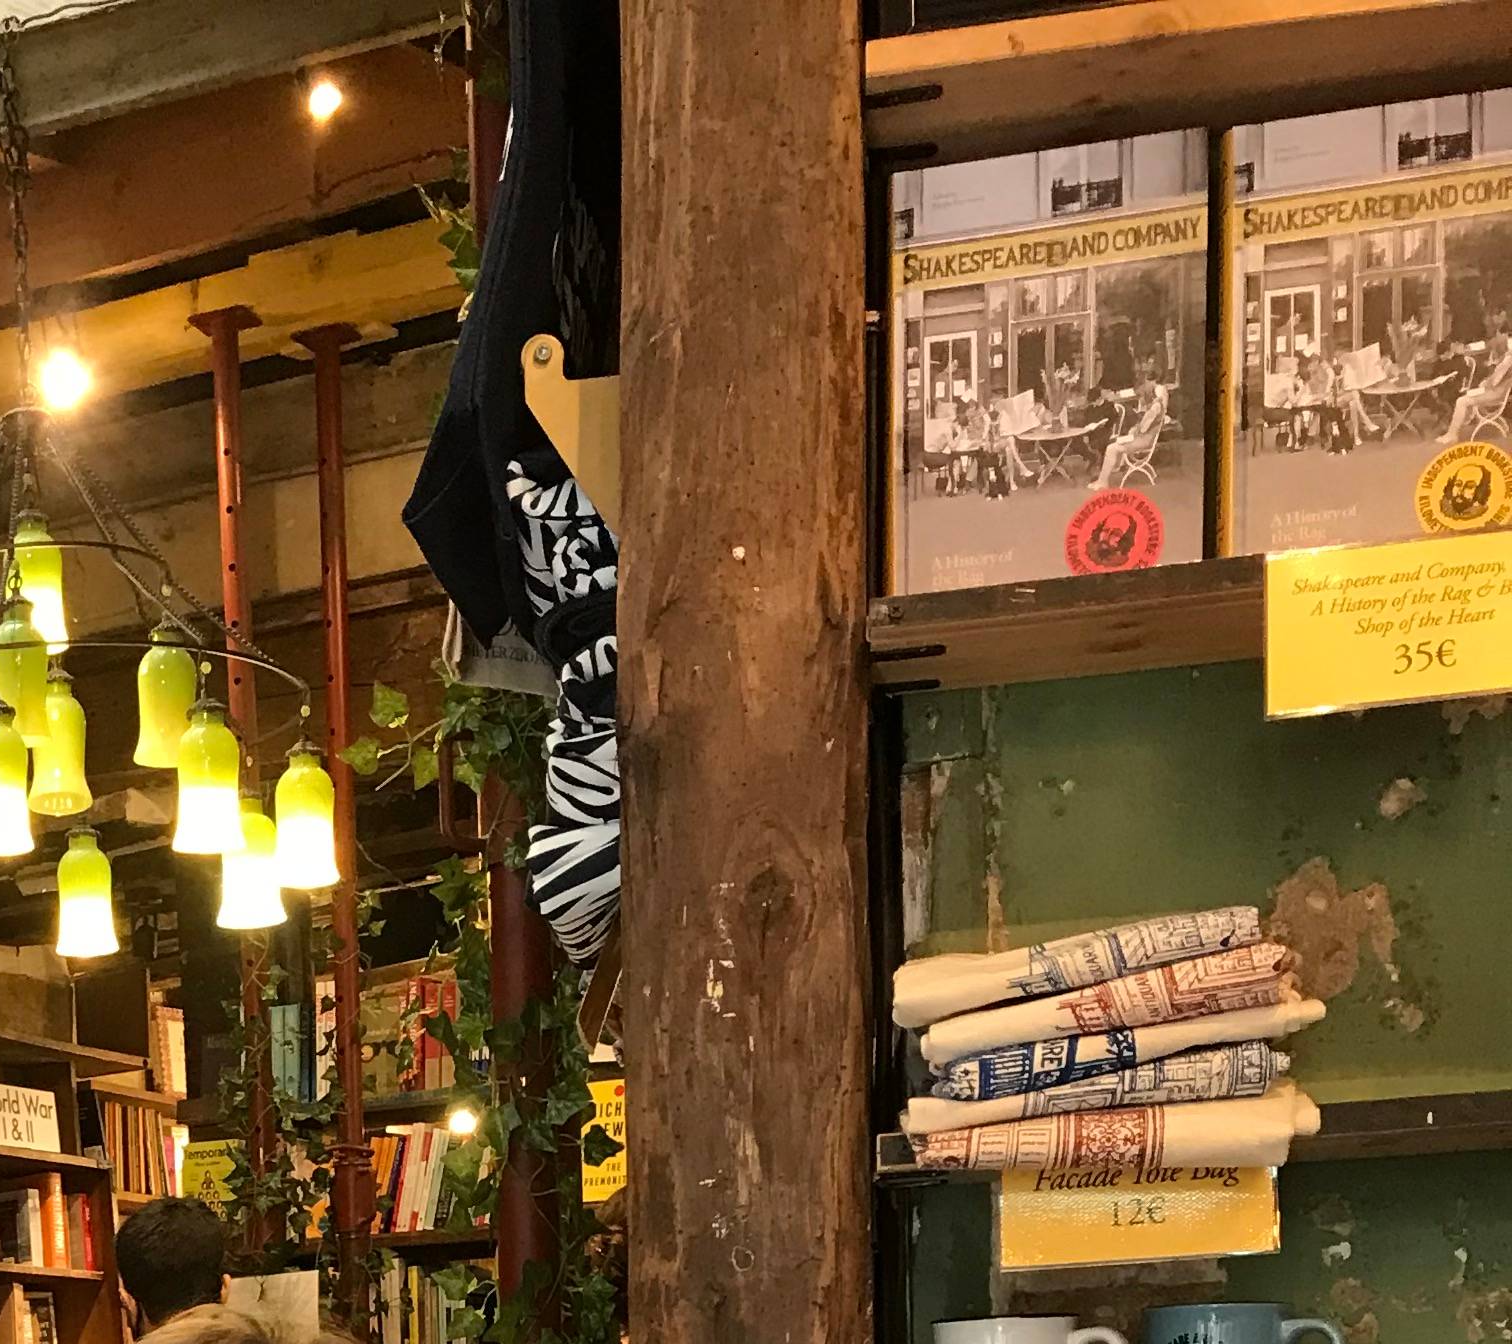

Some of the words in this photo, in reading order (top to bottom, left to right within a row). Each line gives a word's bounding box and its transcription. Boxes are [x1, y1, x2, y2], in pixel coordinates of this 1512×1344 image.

[1243, 197, 1388, 239] SHAKESPEARE
[1415, 184, 1458, 211] AND
[903, 243, 1045, 284] SHAKESPEARE
[1070, 232, 1109, 258] AND
[1112, 217, 1201, 251] COMPANY
[1389, 564, 1423, 584] and
[1311, 602, 1325, 617] A
[1329, 595, 1388, 615] History
[1391, 590, 1409, 611] of
[1412, 588, 1437, 606] the
[1440, 584, 1472, 605] Rag
[1354, 618, 1394, 638] Shop
[1398, 614, 1418, 633] of
[1418, 609, 1443, 627] the
[1447, 606, 1497, 627] Heart
[1393, 639, 1458, 676] 35€
[22, 1093, 54, 1120] War
[11, 1118, 23, 1141] &
[1108, 1197, 1167, 1230] 12€
